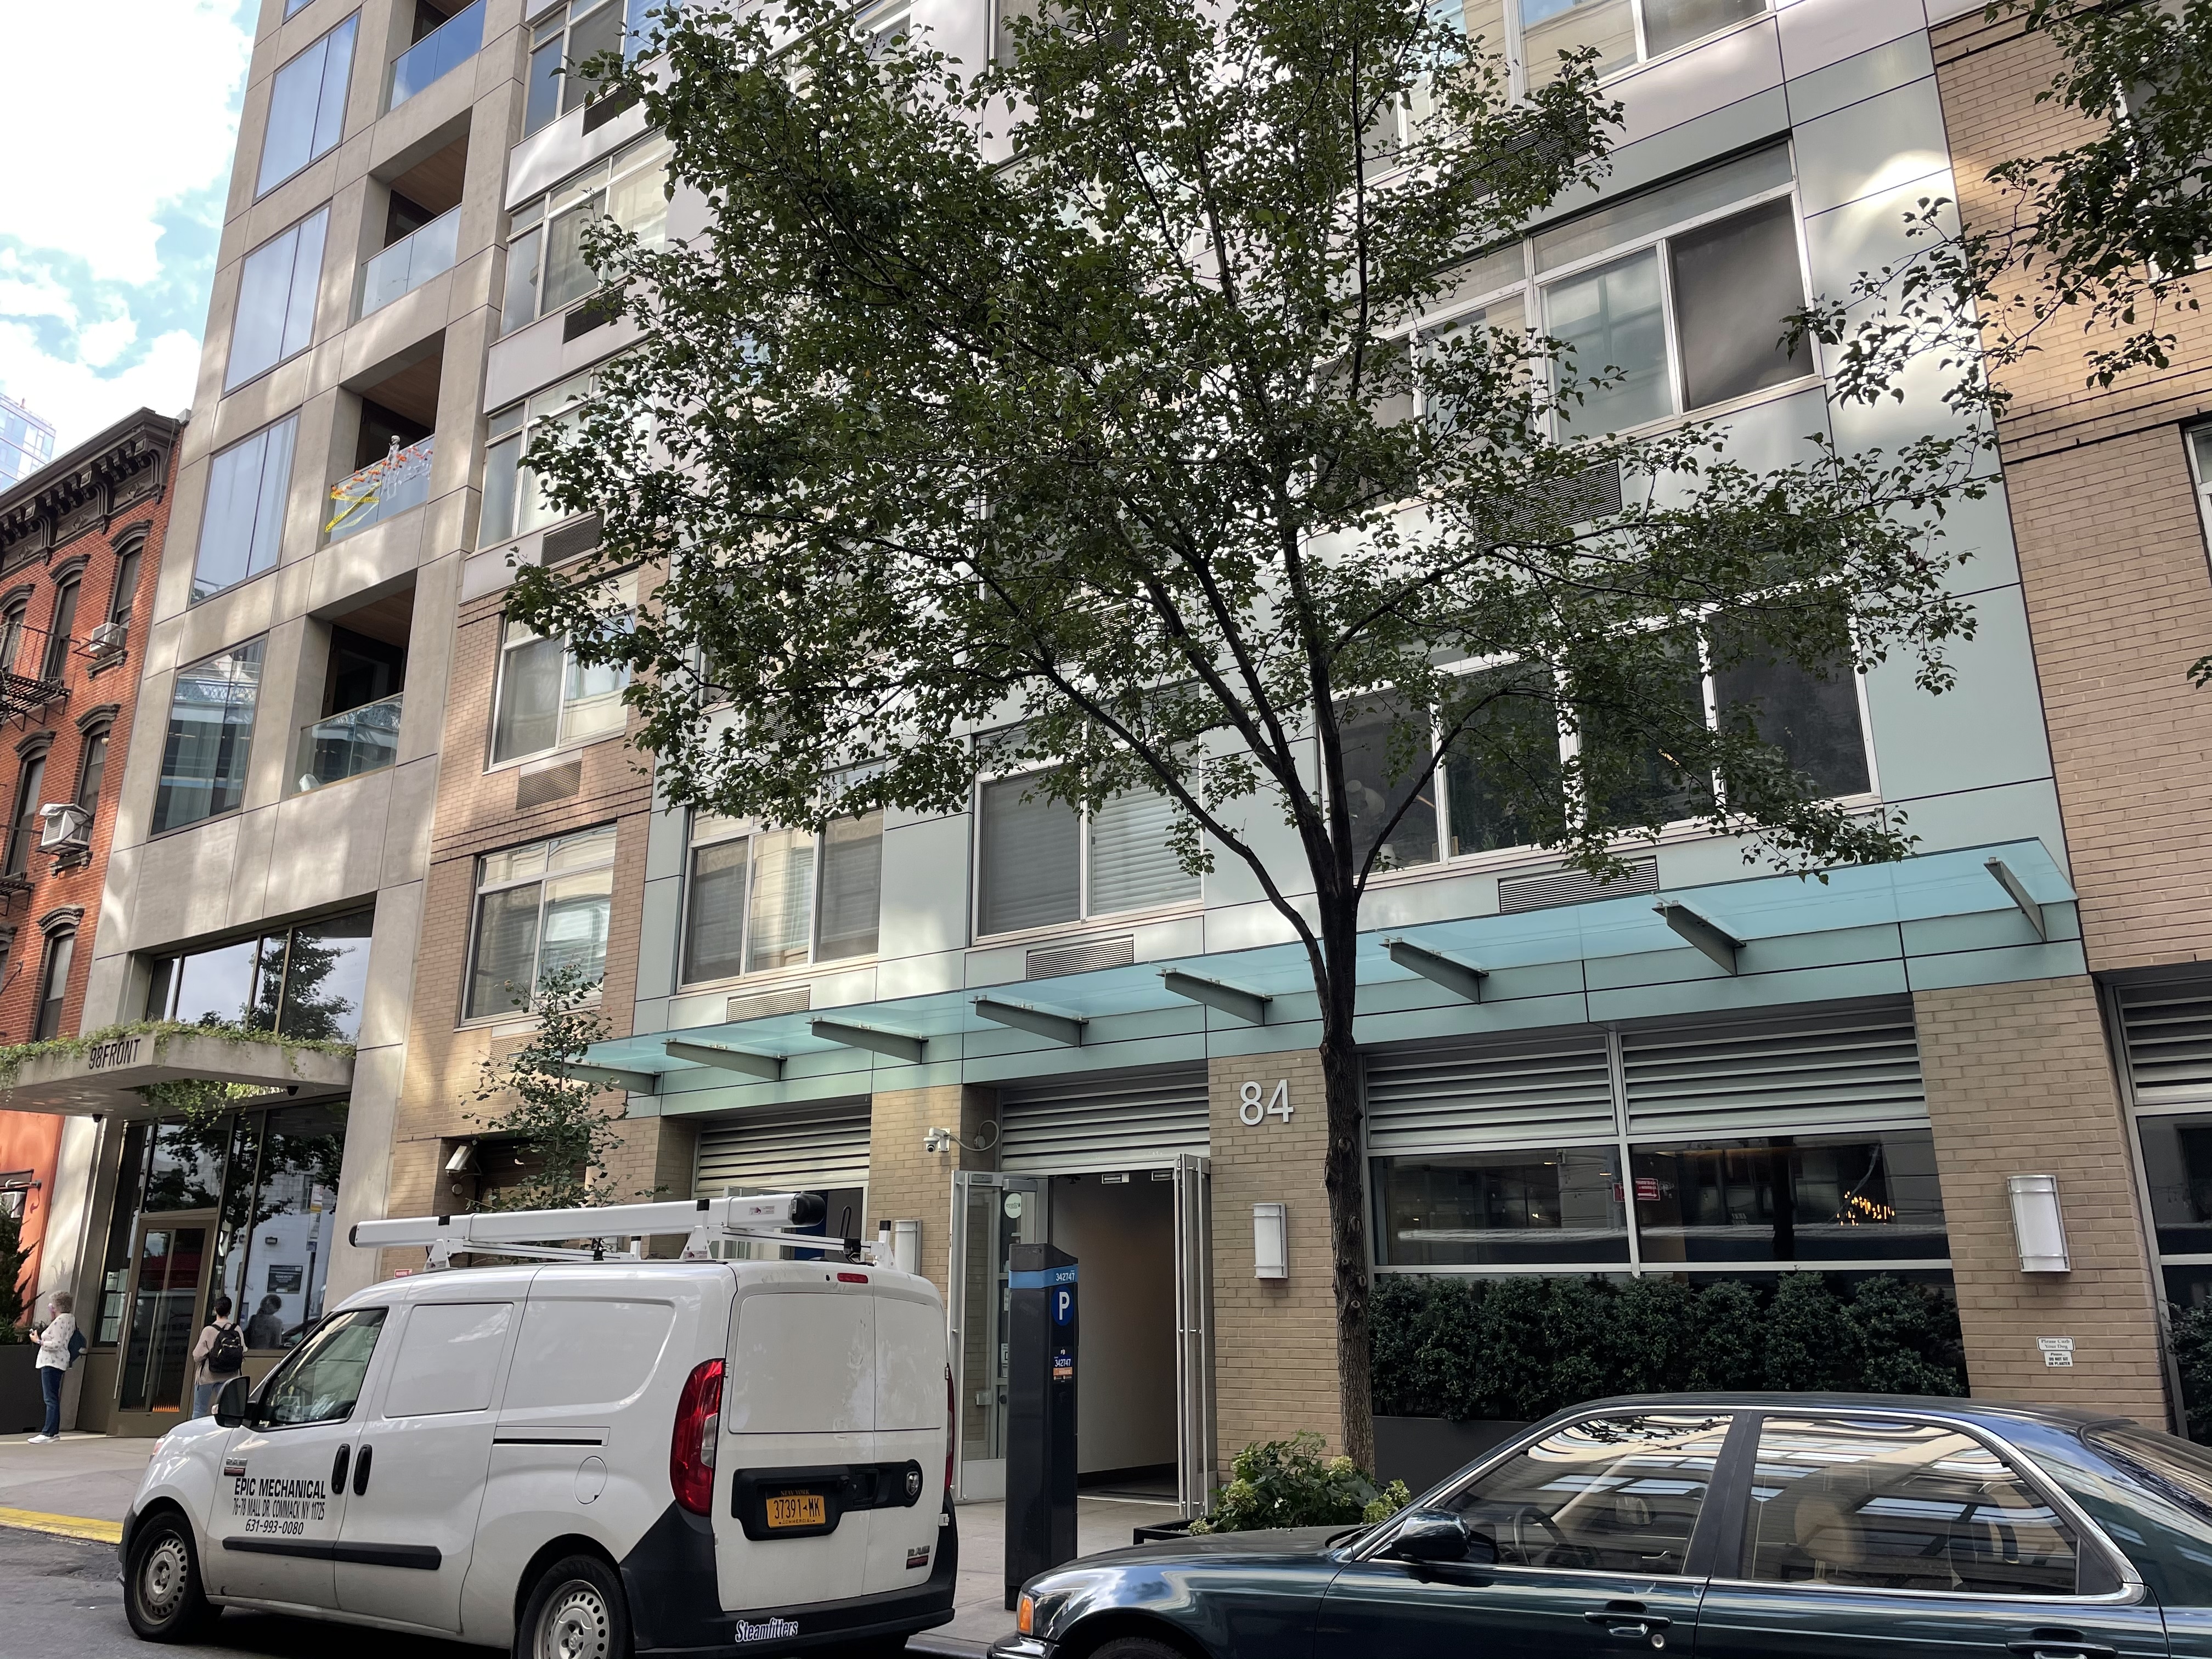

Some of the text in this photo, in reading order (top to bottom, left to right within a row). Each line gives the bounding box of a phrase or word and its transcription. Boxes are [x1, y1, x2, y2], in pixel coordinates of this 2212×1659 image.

[88, 1039, 141, 1069] 98FRONT
[1239, 1079, 1294, 1125] 84
[1056, 1272, 1075, 1282] 342747
[1059, 1291, 1070, 1321] P
[1054, 1358, 1071, 1367] 342747
[234, 1477, 326, 1499] EPIC MECHANICAL
[233, 1498, 325, 1520] 76-78 MALL DR. COMMACK NY 11725
[245, 1519, 304, 1535] 631-993-0080
[735, 1617, 798, 1643] Steamfitters
